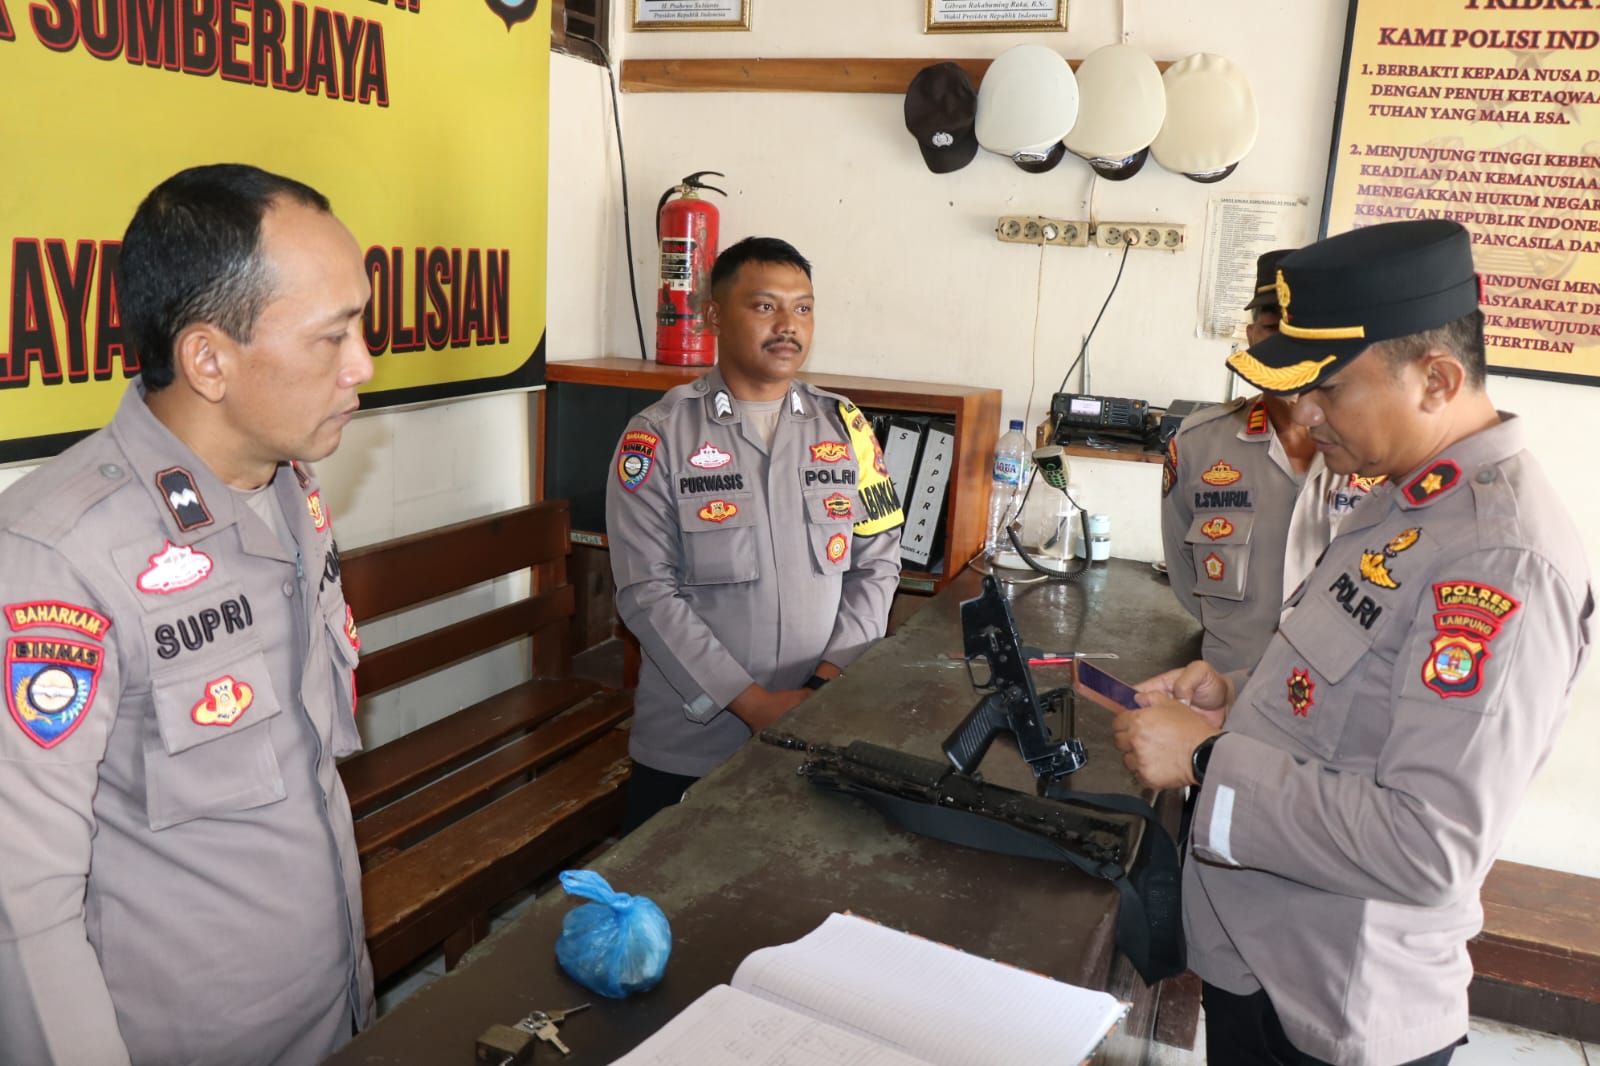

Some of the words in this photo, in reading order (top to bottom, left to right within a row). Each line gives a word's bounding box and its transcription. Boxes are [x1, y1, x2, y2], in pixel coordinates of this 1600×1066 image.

[1378, 27, 1448, 47] KAMI
[1451, 29, 1542, 49] POLISI
[1544, 30, 1600, 50] IND
[1361, 64, 1373, 76] 1.
[1376, 64, 1459, 79] BERBAKTI
[1461, 67, 1531, 81] KEPADA
[1533, 69, 1582, 82] NUSA
[1585, 69, 1600, 82] D
[1370, 84, 1442, 99] DENGAN
[1444, 87, 1505, 101] PENUH
[1369, 104, 1428, 119] TUHAN
[1430, 107, 1476, 121] YANG
[1478, 109, 1531, 123] MAHA
[1533, 112, 1571, 125] ESA.
[1350, 143, 1362, 156] 2.
[1365, 144, 1475, 163] MENJUNJUNG
[1478, 151, 1541, 167] TINGGI
[1360, 164, 1443, 181] KEADILAN
[1445, 169, 1482, 183] DAN
[1485, 172, 1600, 190] KEMANUSIAA
[1357, 184, 1473, 203] MENEGAKKAN
[1475, 192, 1542, 207] HUKUM
[1354, 203, 1441, 220] KESATUAN
[1443, 210, 1525, 227] REPUBLIK
[1527, 213, 1600, 232] INDONE
[1472, 233, 1565, 250] PANCASILA
[1484, 274, 1561, 291] INDUNGI
[363, 244, 510, 357] OLISIAN
[1481, 294, 1578, 313] ASYARAKAT
[1505, 316, 1600, 336] MEWUJUDK
[1484, 334, 1575, 354] ETERTIBAN
[680, 474, 744, 494] PURWASIS
[805, 469, 856, 486] POLRI
[1328, 572, 1383, 630] POLRI
[1441, 585, 1512, 611] POLRES
[15, 605, 100, 634] BAHARKAM
[154, 594, 253, 660] SUPRI
[1440, 615, 1494, 635] LAMPUNG
[15, 641, 98, 665] BINMAS
